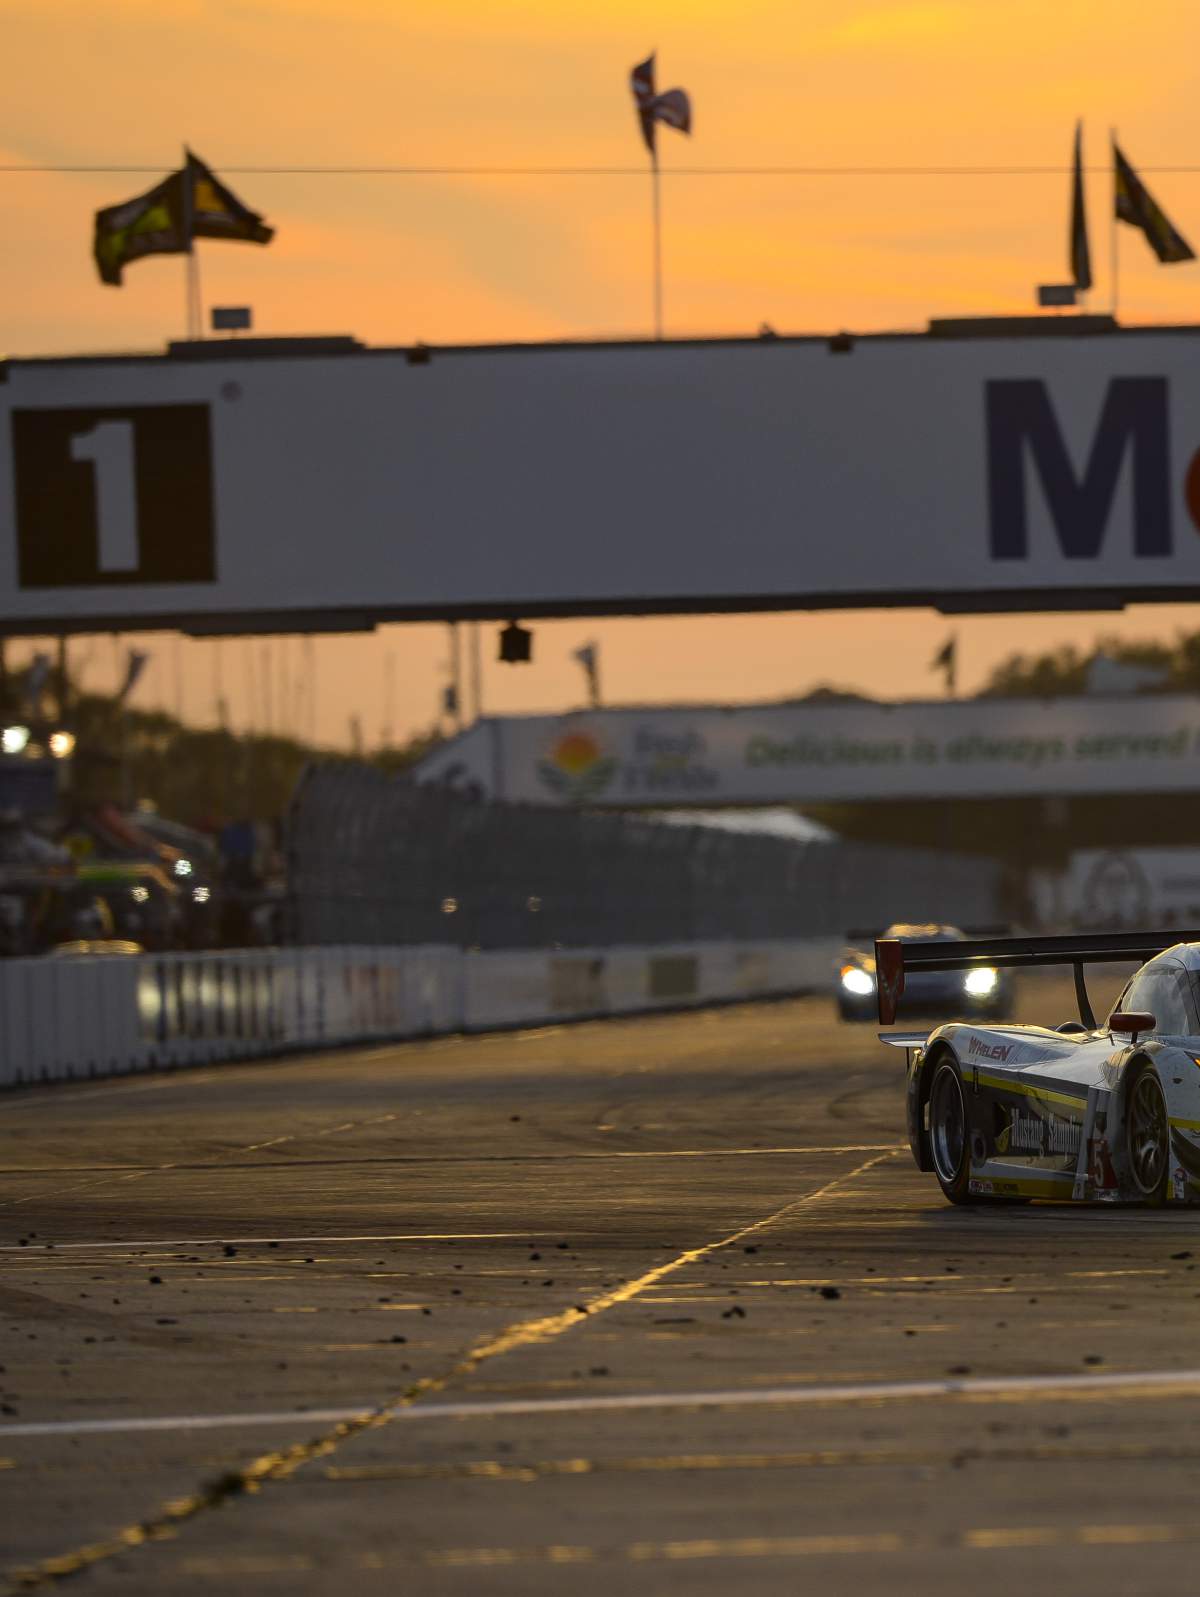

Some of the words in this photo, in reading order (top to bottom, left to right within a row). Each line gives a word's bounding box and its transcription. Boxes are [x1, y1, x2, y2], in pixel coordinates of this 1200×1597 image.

[71, 420, 140, 572] 1
[1075, 723, 1190, 760] served
[968, 1036, 1015, 1061] WHELEN
[1093, 1143, 1105, 1184] 5
